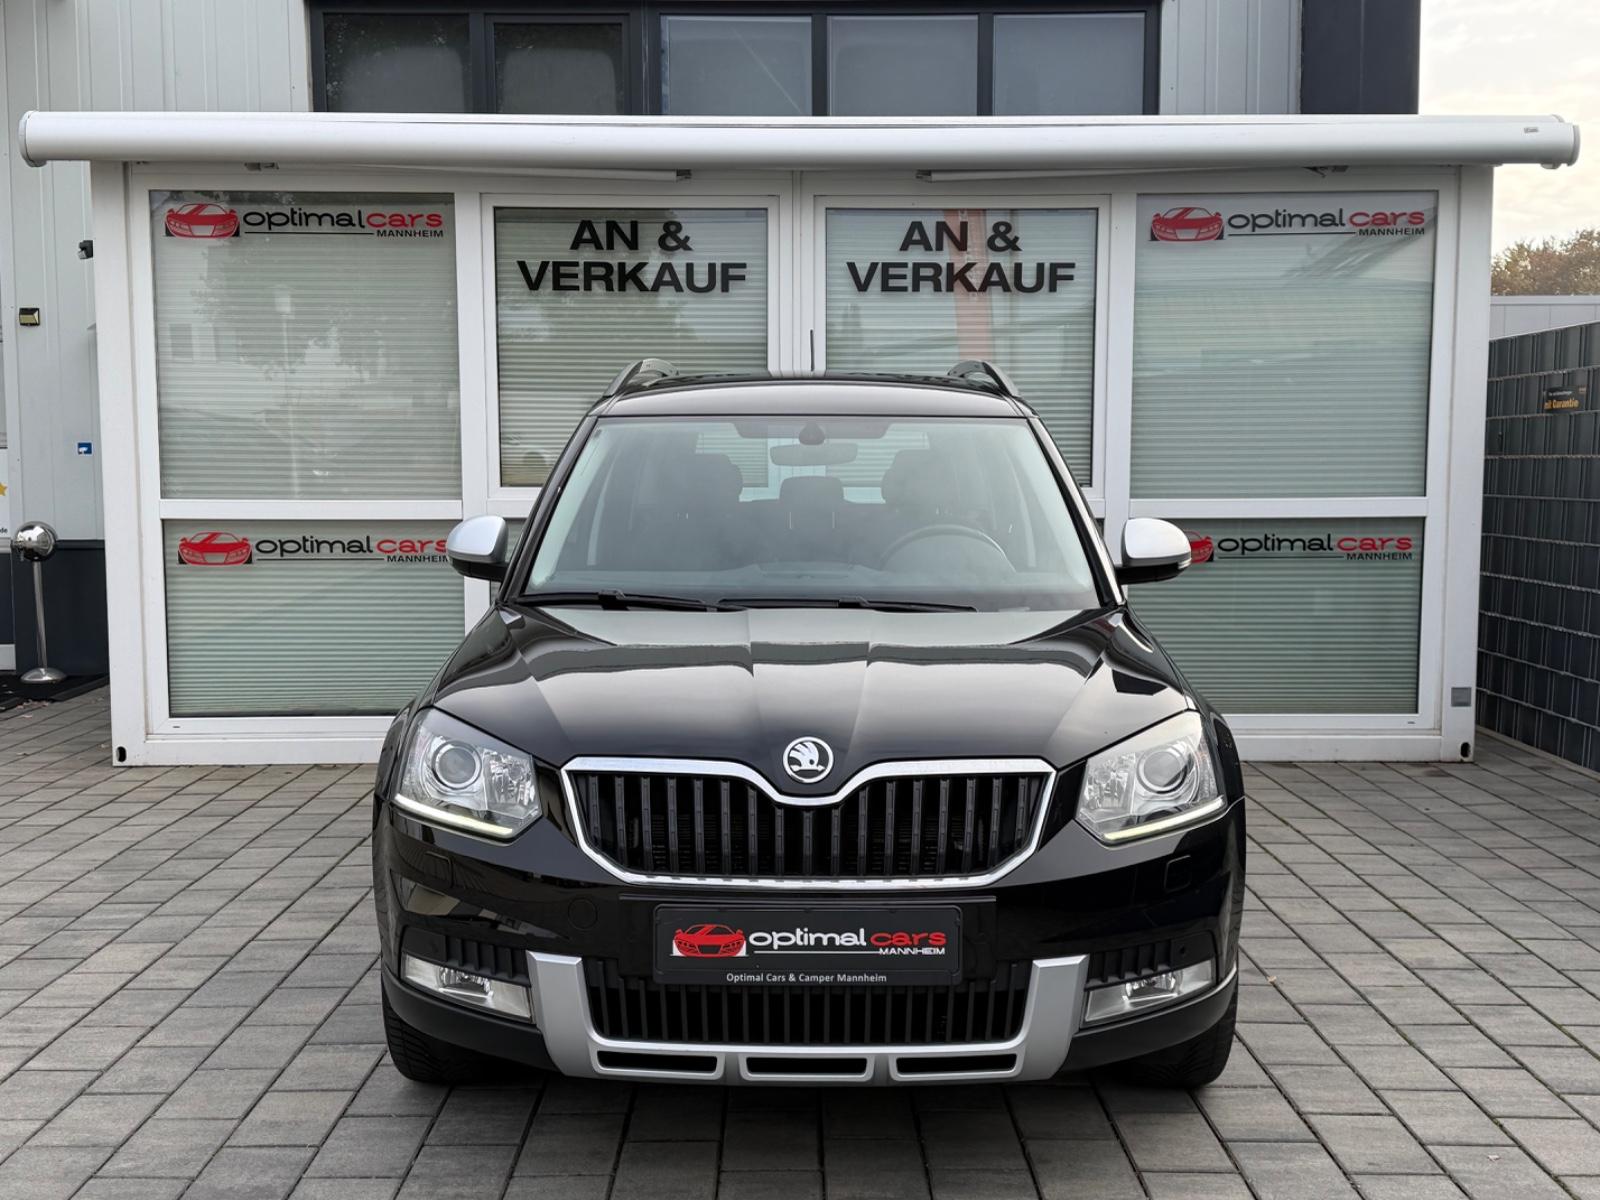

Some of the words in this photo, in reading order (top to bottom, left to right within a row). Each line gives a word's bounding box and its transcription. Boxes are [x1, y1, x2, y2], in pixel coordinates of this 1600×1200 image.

[376, 229, 444, 238] MANNHEIM
[569, 220, 638, 250] AN
[657, 220, 694, 251] &
[899, 221, 969, 251] AN
[986, 221, 1022, 252] &
[1359, 228, 1425, 237] MANNHEIM
[516, 260, 747, 293] VERKAUF
[846, 261, 1076, 293] VERKAUF
[1346, 552, 1413, 561] MANNHEIM
[879, 947, 945, 955] MANNHEIM
[726, 972, 764, 984] Optimal
[766, 972, 786, 982] Cars
[788, 973, 796, 982] &
[798, 972, 835, 984] Camper
[837, 972, 887, 982] Mannheim
